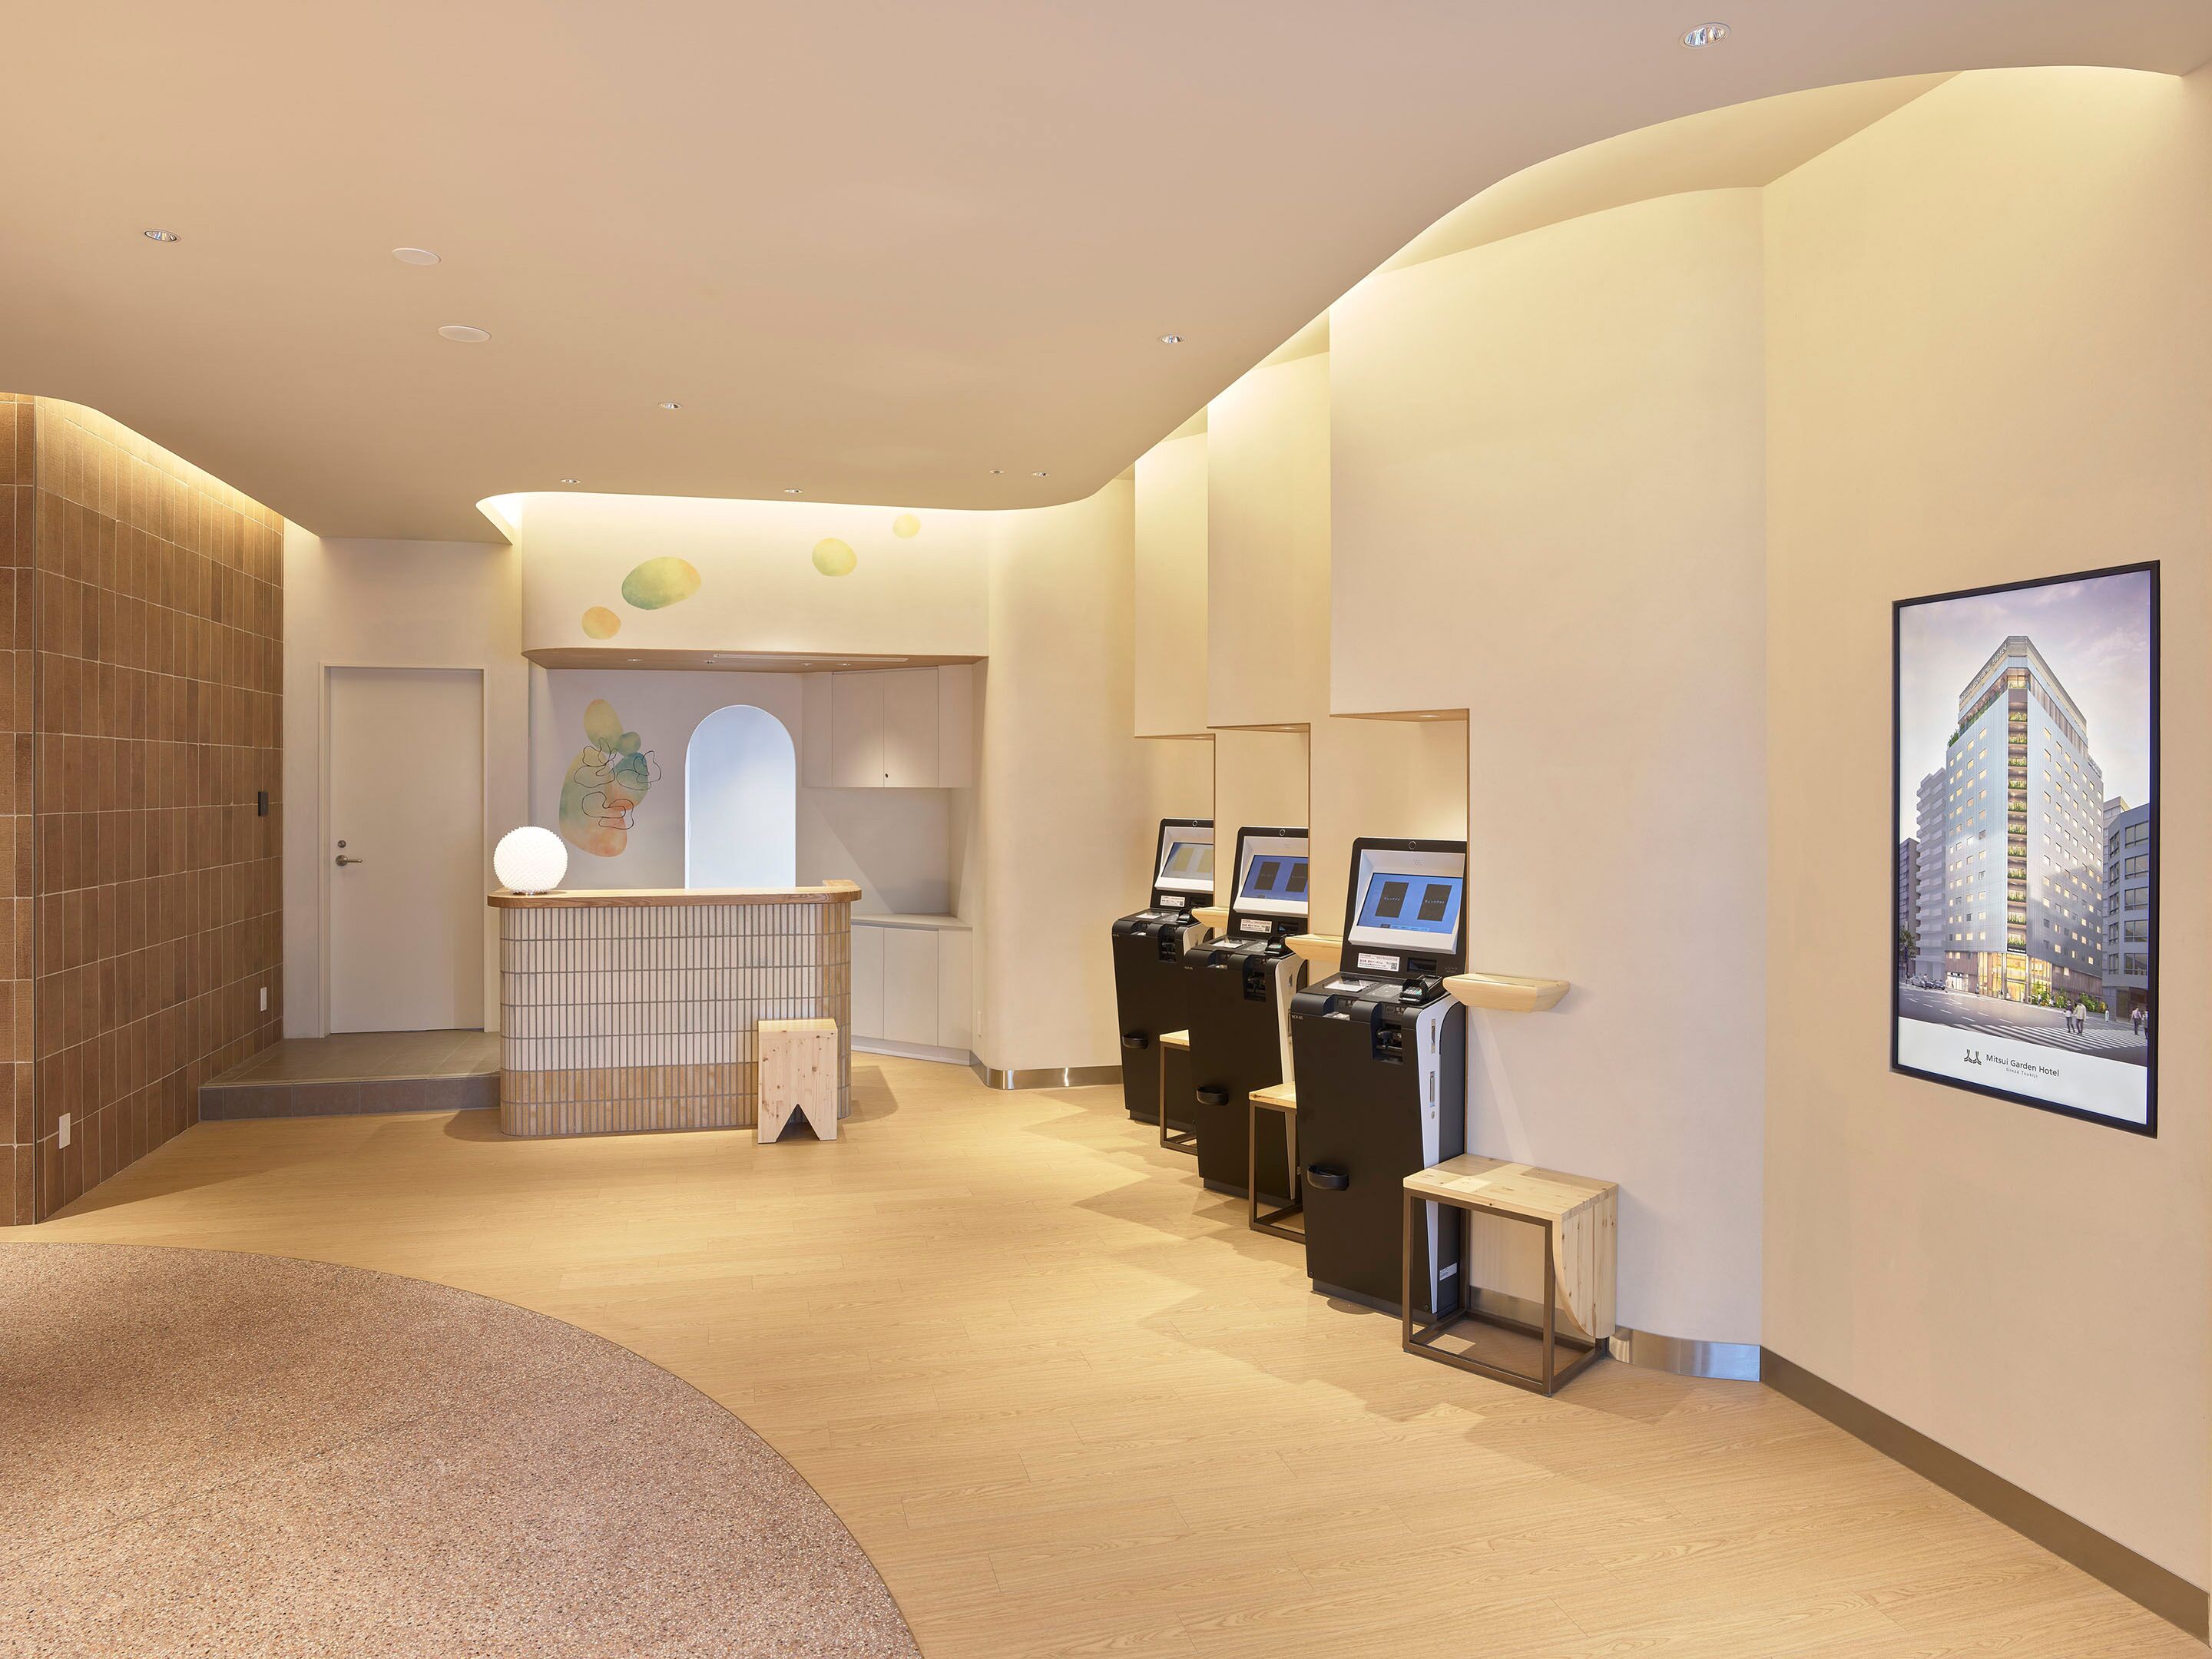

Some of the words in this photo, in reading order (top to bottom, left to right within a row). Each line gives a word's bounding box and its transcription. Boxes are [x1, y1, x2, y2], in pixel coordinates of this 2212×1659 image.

[1986, 1055, 2008, 1065] Mitsui
[2010, 1060, 2037, 1072] Garden
[2039, 1066, 2059, 1077] Hotel
